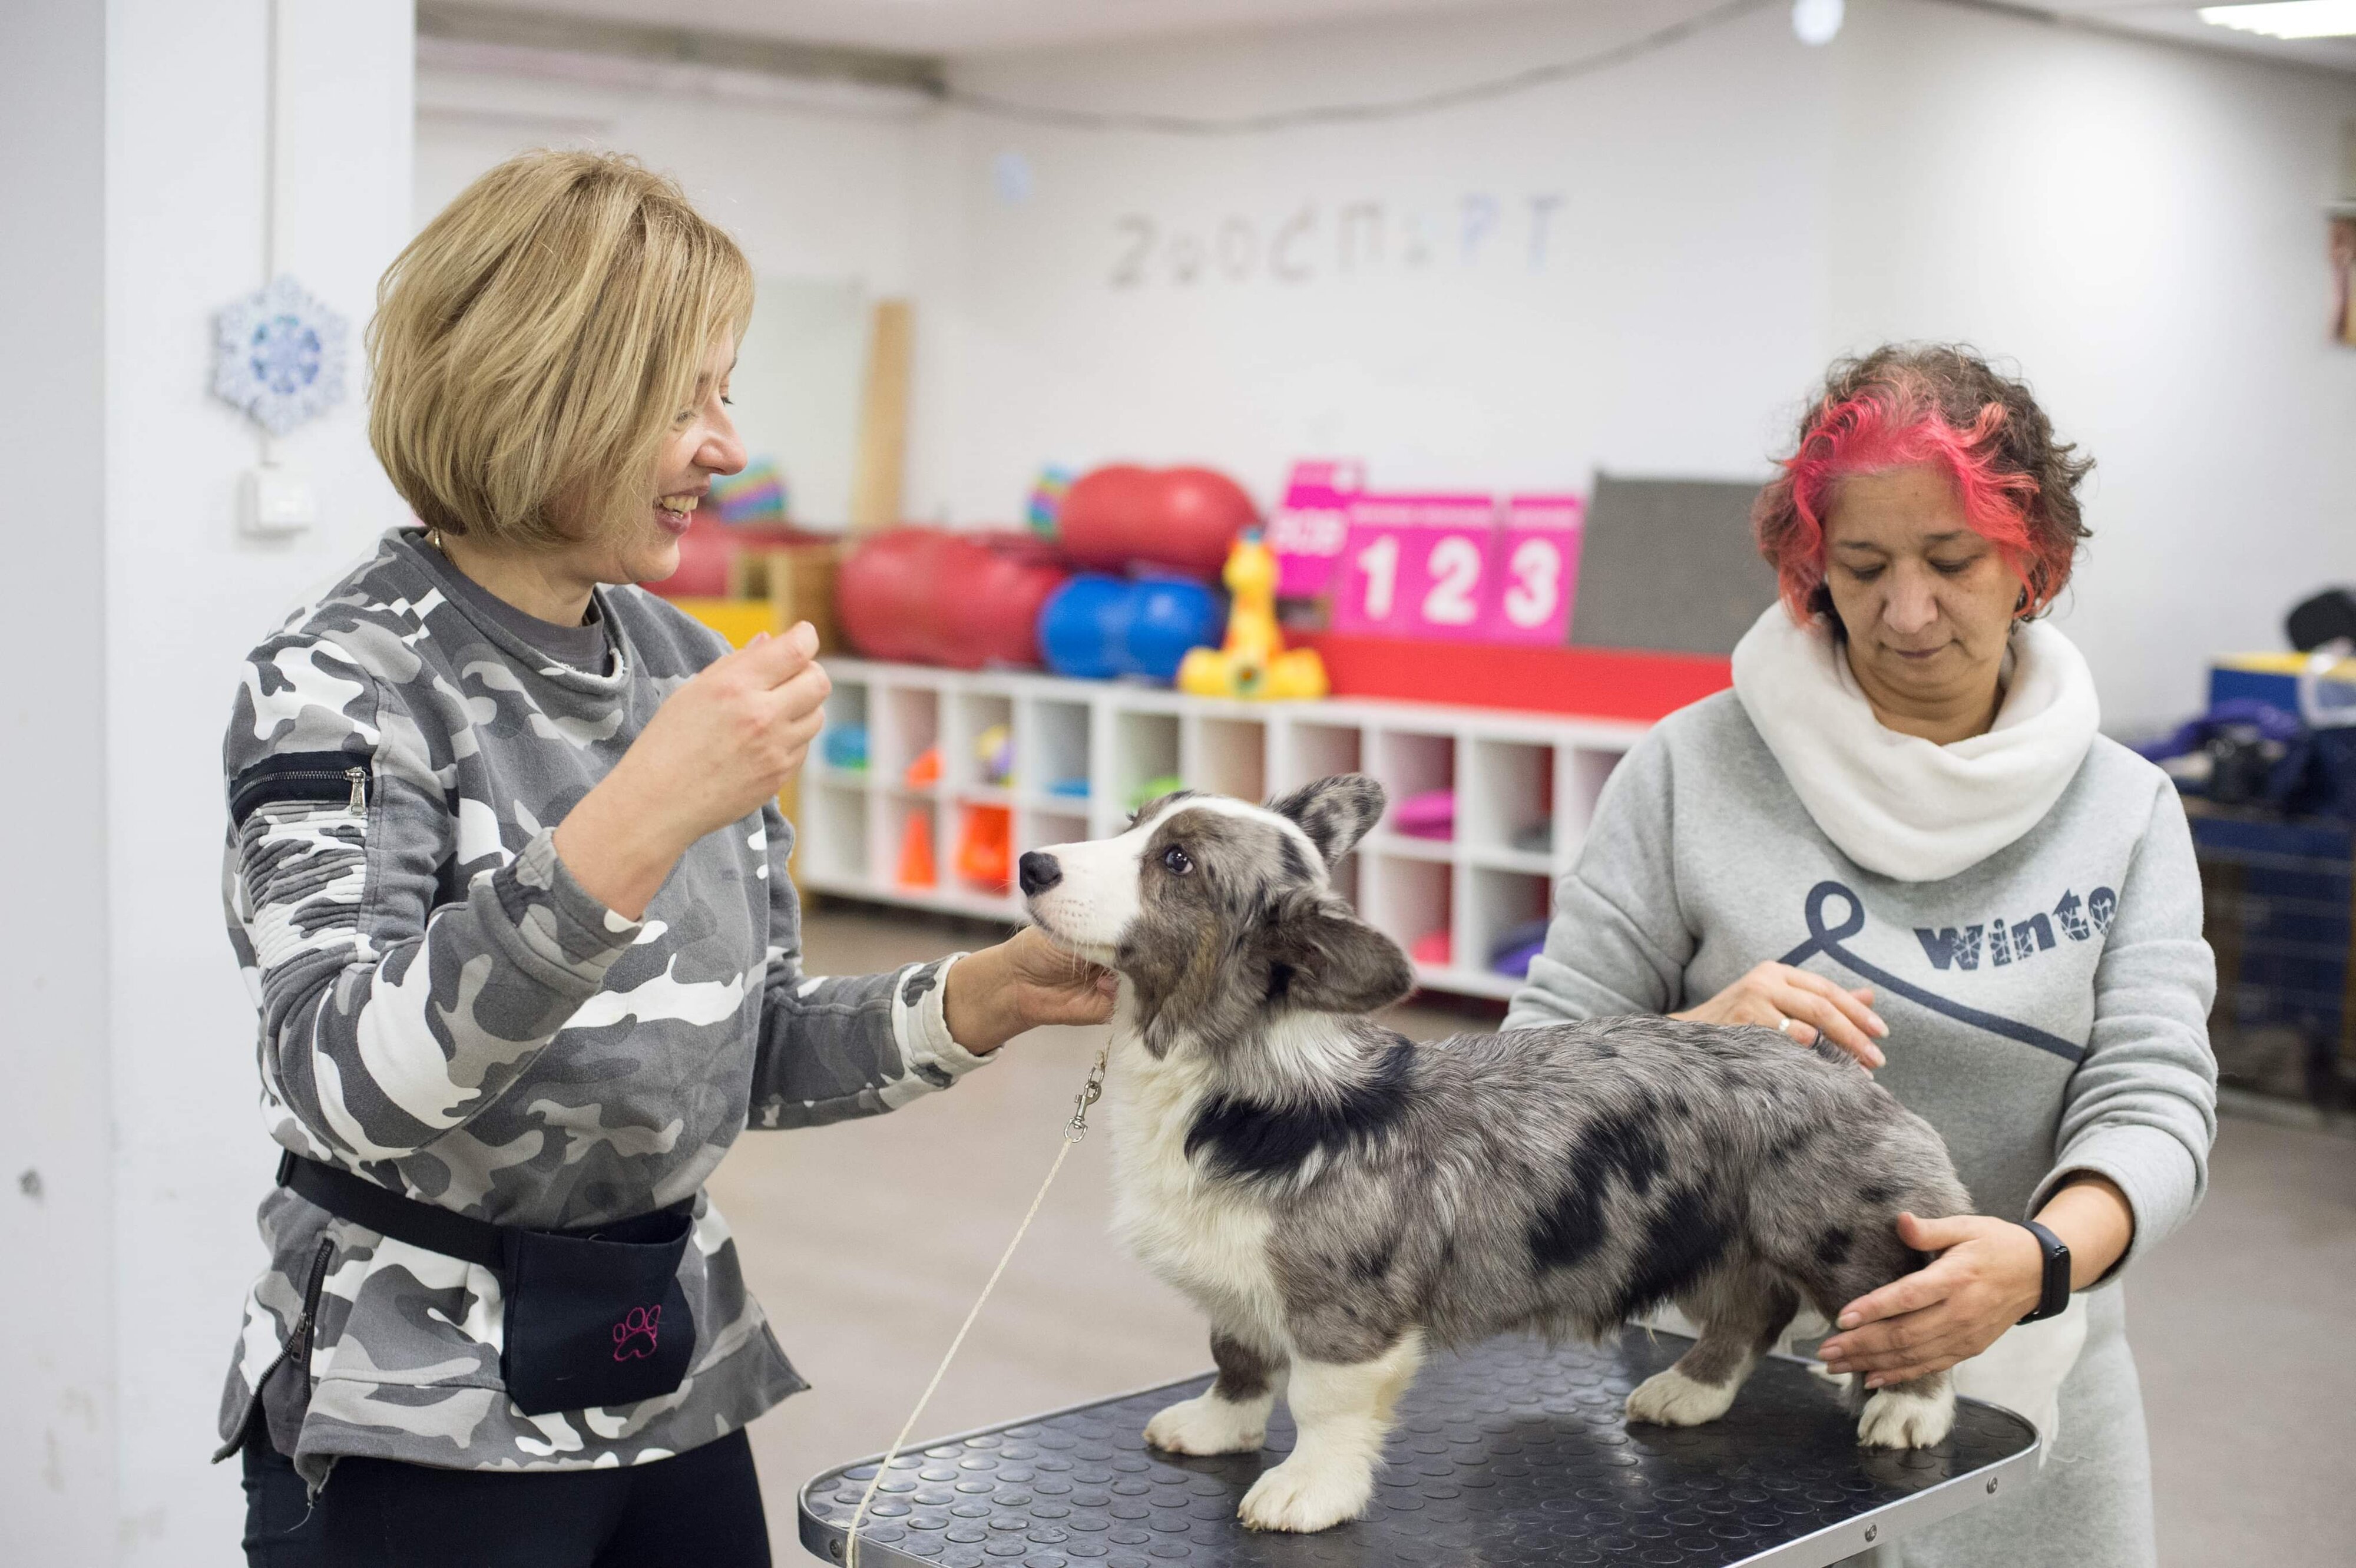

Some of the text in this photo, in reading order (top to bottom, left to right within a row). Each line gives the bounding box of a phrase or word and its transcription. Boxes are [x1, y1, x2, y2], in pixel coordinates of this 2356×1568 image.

[1358, 534, 1560, 628] 1 2 3
